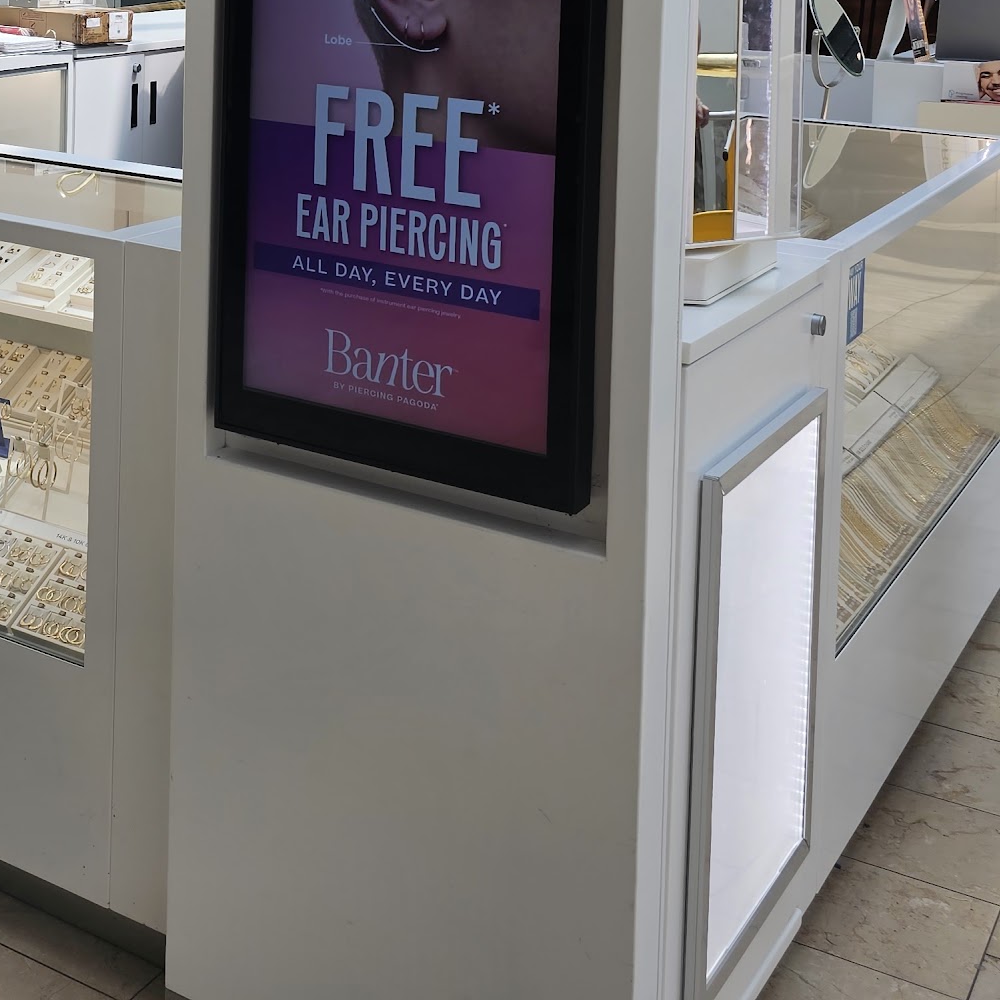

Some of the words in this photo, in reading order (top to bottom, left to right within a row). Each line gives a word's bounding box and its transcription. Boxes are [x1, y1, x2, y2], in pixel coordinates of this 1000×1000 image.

[324, 33, 353, 46] Lobe
[296, 192, 351, 245] EAR
[360, 202, 502, 271] PIERCING
[292, 255, 329, 275] ALL
[335, 262, 377, 287] DAY,
[384, 271, 453, 297] EVERY
[460, 285, 503, 306] DAY
[344, 292, 369, 302] purchase
[417, 306, 441, 316] piercing
[324, 328, 453, 398] Banter
[333, 381, 346, 390] BY
[348, 384, 394, 402] PIERCING
[396, 395, 438, 411] PAGODA
[56, 533, 67, 541] 14K
[73, 538, 85, 546] 10K
